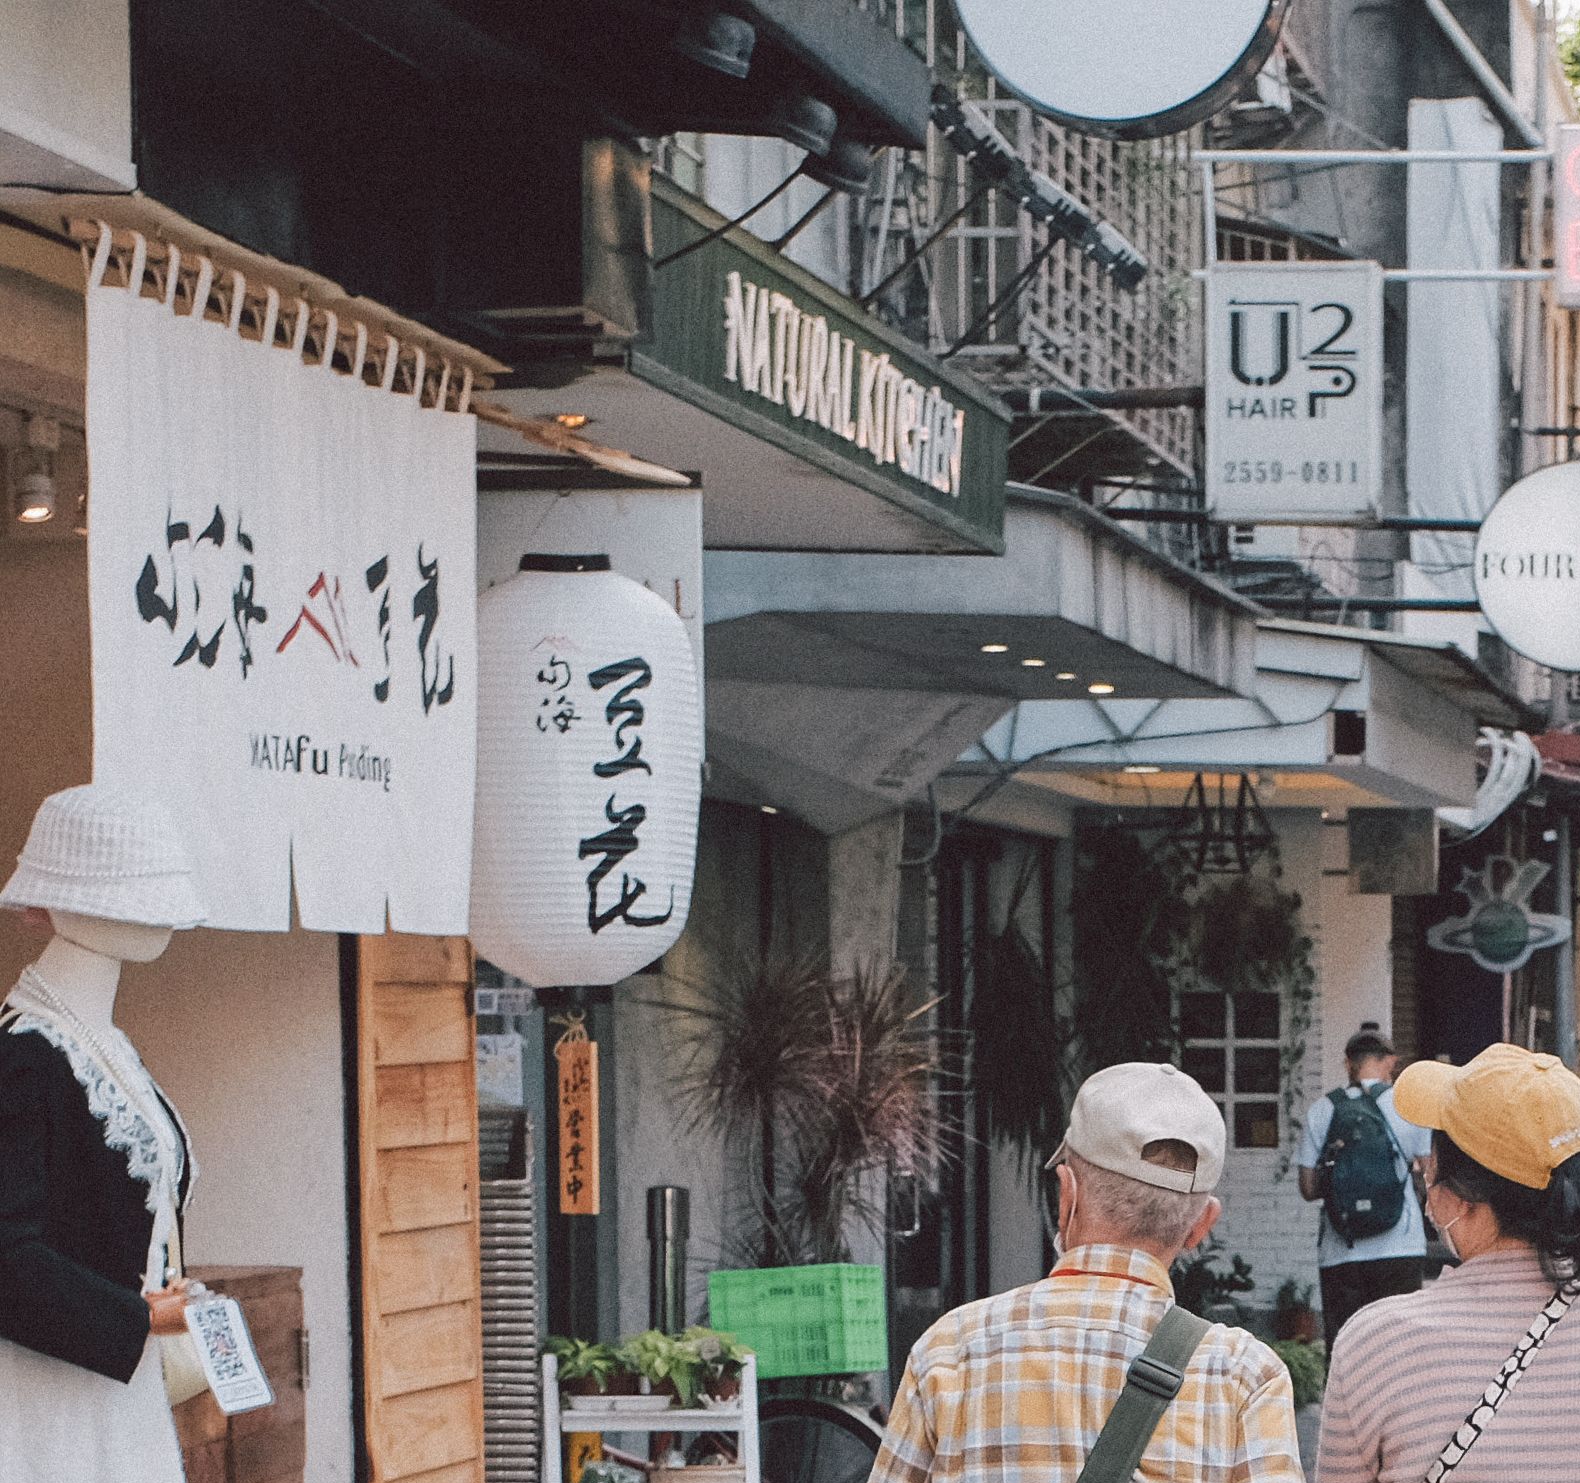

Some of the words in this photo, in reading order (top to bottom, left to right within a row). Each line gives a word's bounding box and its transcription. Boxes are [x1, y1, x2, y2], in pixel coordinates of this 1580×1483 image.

[724, 271, 856, 441] NATURAL
[1228, 397, 1296, 419] HAIR
[1224, 461, 1359, 485] 2559-0811
[1482, 552, 1578, 579] FOUR
